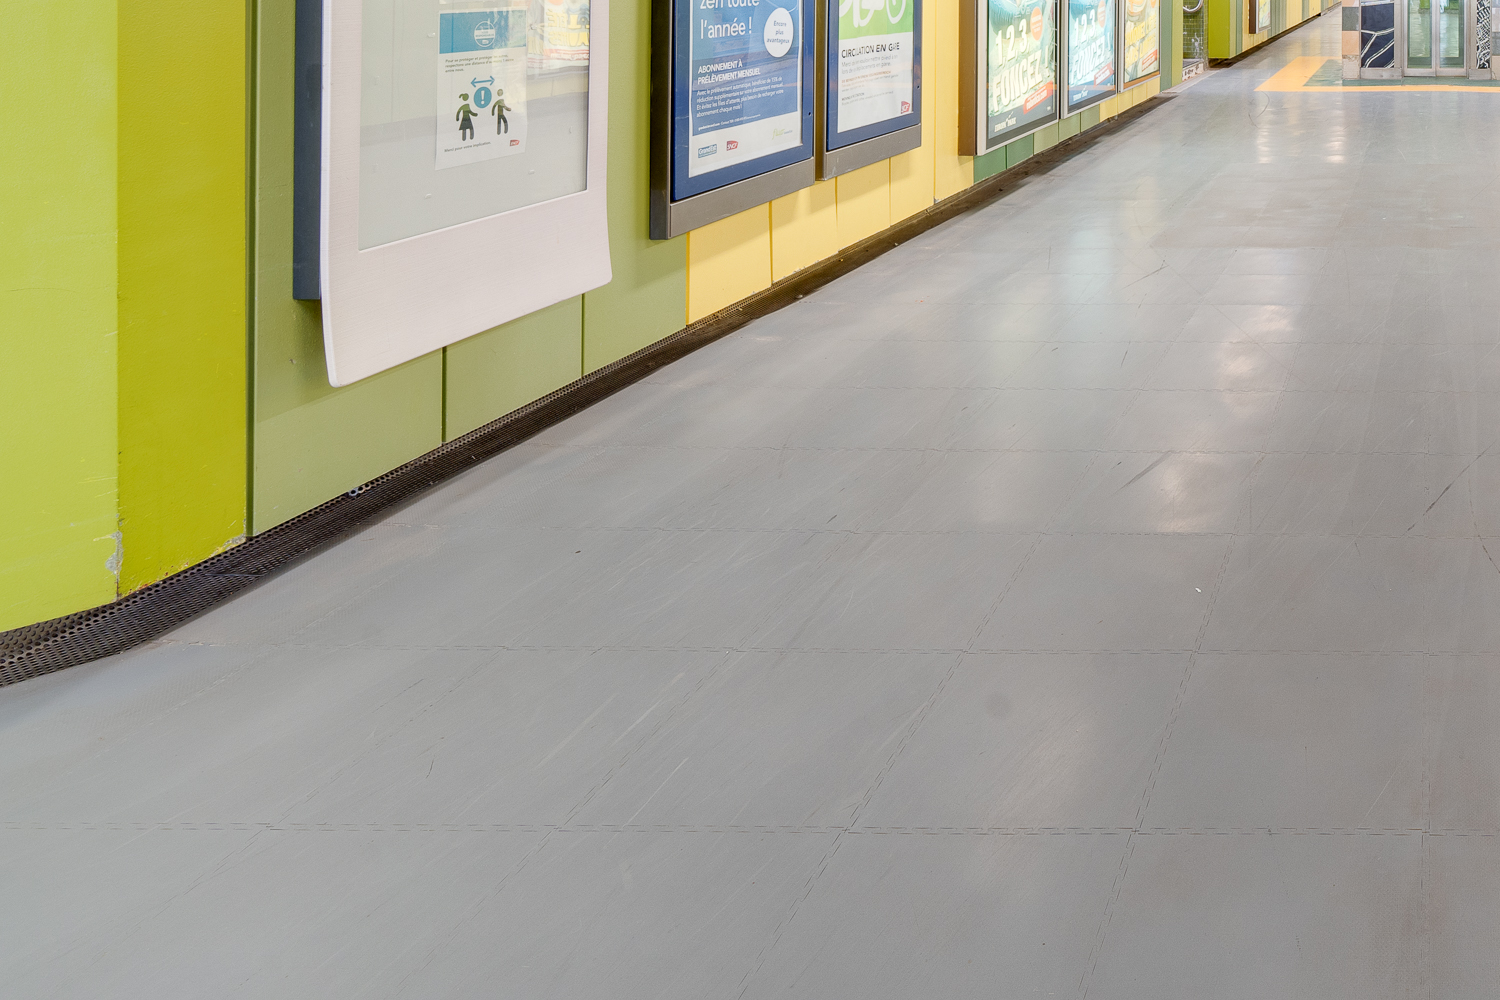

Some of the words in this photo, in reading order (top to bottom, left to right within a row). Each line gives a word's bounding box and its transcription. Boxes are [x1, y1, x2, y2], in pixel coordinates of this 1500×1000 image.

[701, 17, 746, 39] l'année
[767, 37, 790, 45] avantageux
[841, 45, 875, 59] CIRCLATION
[876, 44, 887, 53] EN
[698, 60, 738, 74] ABONNEMENT
[1070, 35, 1105, 86] FONCEZ
[697, 72, 738, 85] PRÉLÈVEMENT
[737, 68, 761, 78] MENSUEL
[992, 50, 1043, 113] FONCEZ
[727, 142, 738, 150] SNCF
